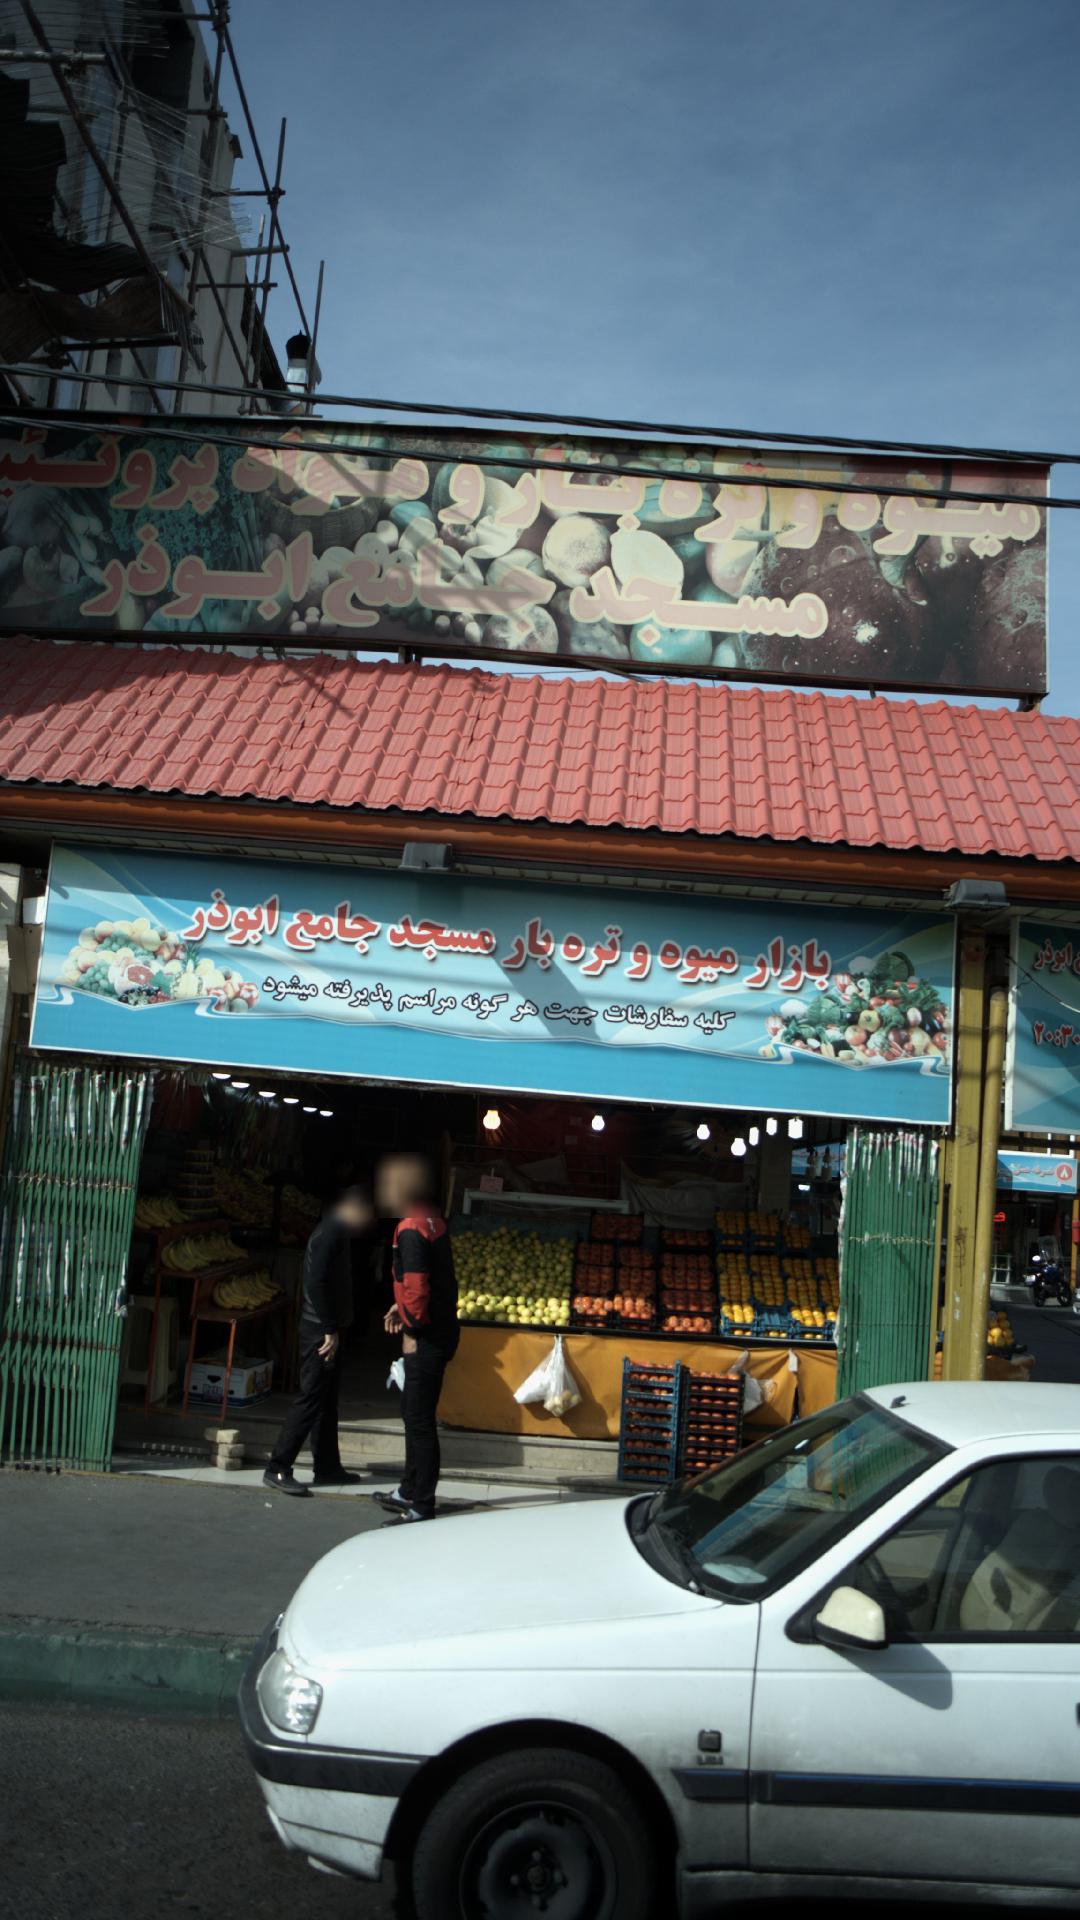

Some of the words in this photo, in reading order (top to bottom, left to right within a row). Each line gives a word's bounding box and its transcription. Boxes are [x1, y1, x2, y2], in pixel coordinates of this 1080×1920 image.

[438, 462, 486, 525] و
[494, 442, 646, 532] بار
[775, 491, 824, 550] و
[836, 491, 1042, 557] میوه
[81, 524, 312, 619] ابوذر
[322, 541, 556, 635] جامع
[569, 566, 829, 648] مسجد
[180, 888, 280, 945] ابوذر
[283, 900, 383, 955] جامع
[386, 914, 497, 961] مسجد
[501, 917, 556, 970] بار
[560, 924, 622, 976] تره
[624, 940, 652, 979] و
[658, 939, 739, 983] میوه
[743, 935, 832, 990] بازار
[261, 974, 318, 999] میشود
[323, 979, 393, 1011] پذیرفته
[398, 987, 457, 1016] مراسم
[461, 992, 510, 1020] گونه
[510, 1000, 539, 1023] هر
[543, 1001, 598, 1026] جهت
[602, 1003, 690, 1030] سفارشات
[693, 1010, 736, 1034] کلیه
